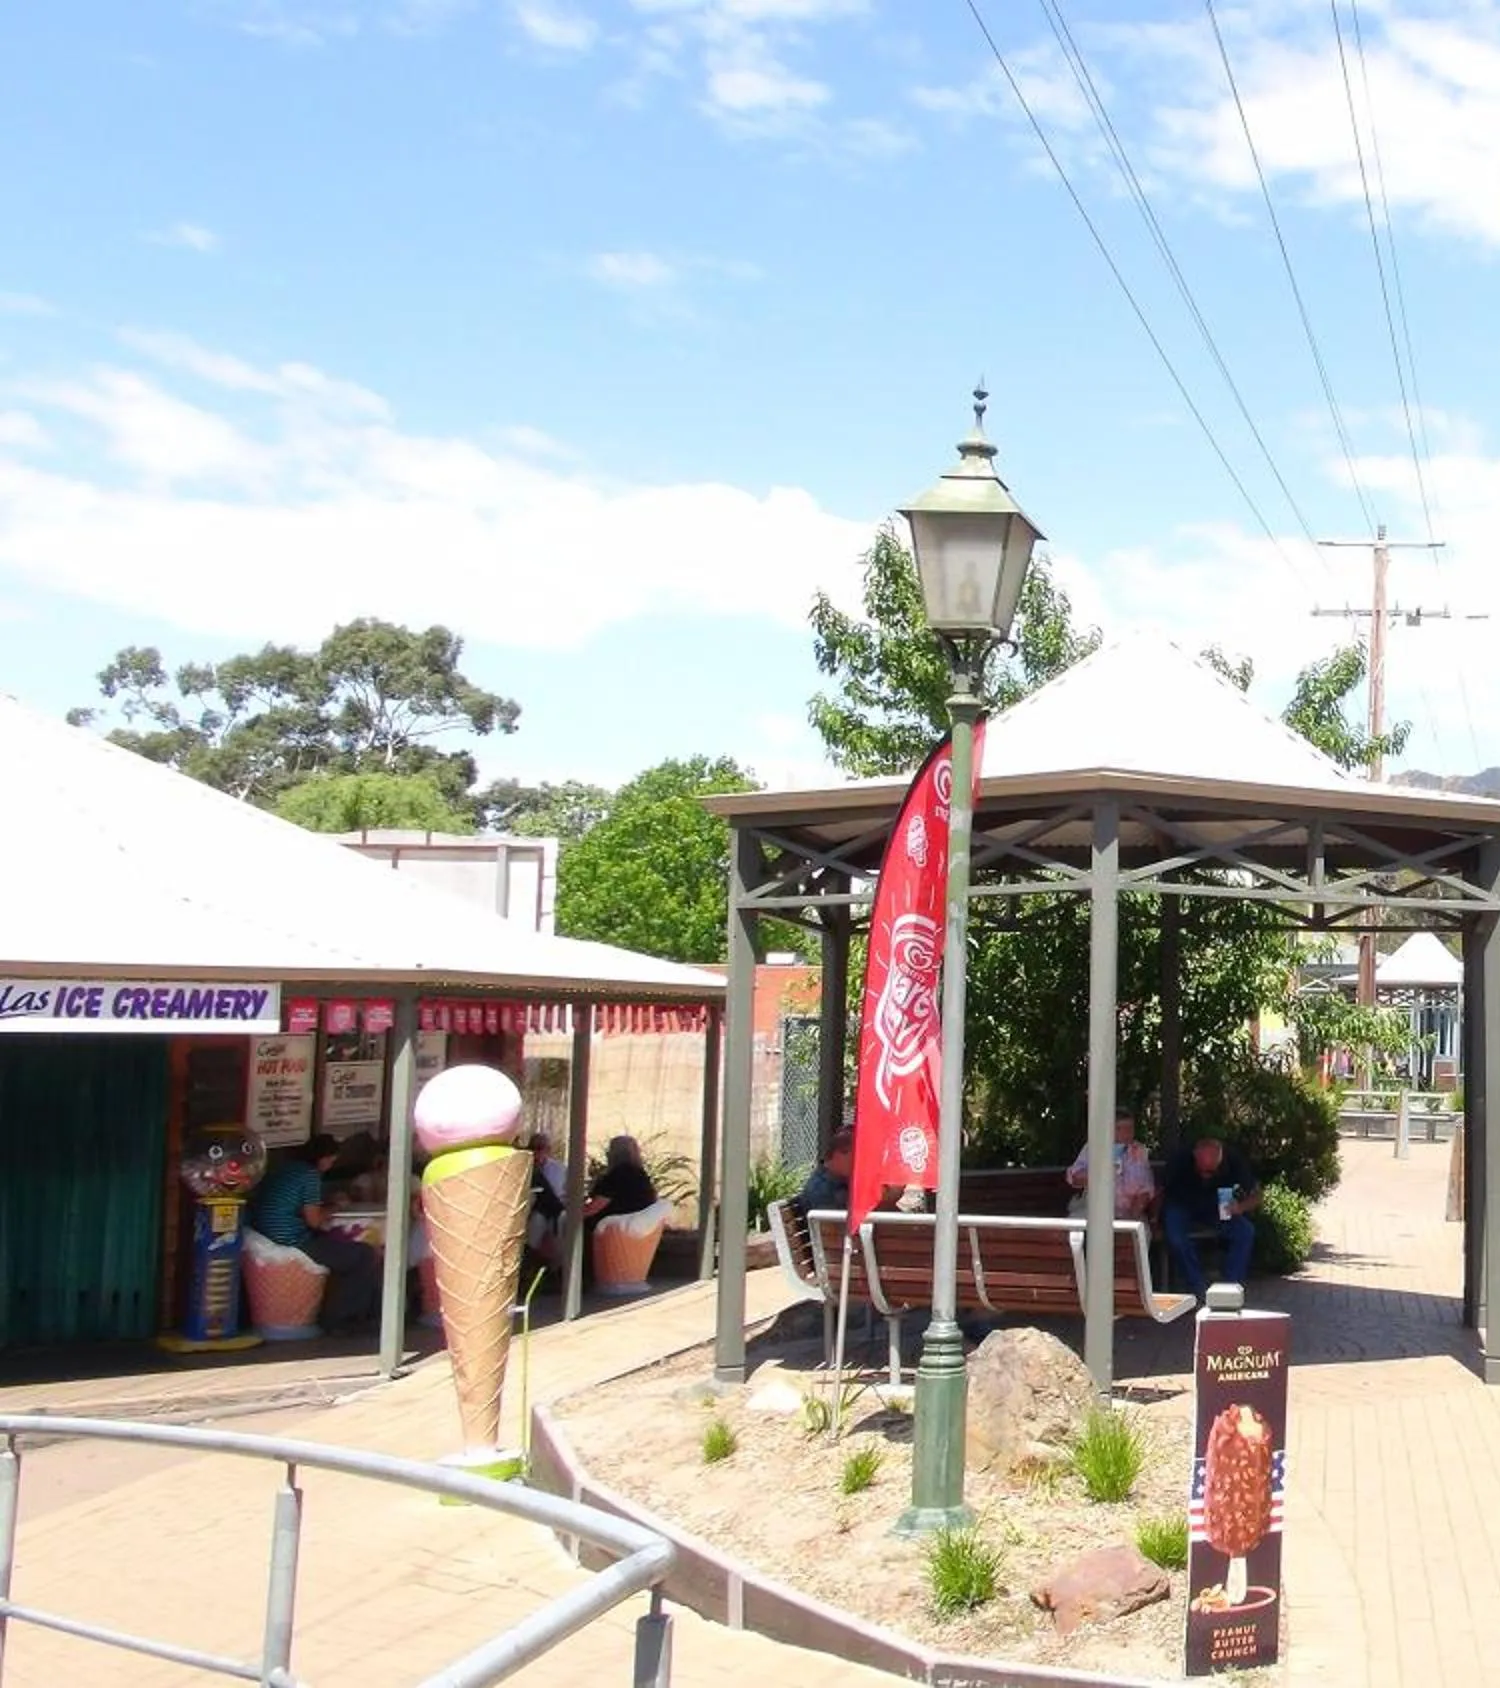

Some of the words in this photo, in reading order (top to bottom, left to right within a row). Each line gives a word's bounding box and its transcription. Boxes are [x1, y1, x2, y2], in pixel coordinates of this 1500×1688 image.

[53, 986, 104, 1018] ICE
[111, 987, 269, 1021] CREAMERY
[1206, 1350, 1281, 1372] MAGNUM
[1213, 1624, 1257, 1639] PEANUT
[1214, 1635, 1255, 1649] BUTTER
[1211, 1645, 1257, 1660] CRUNCH
